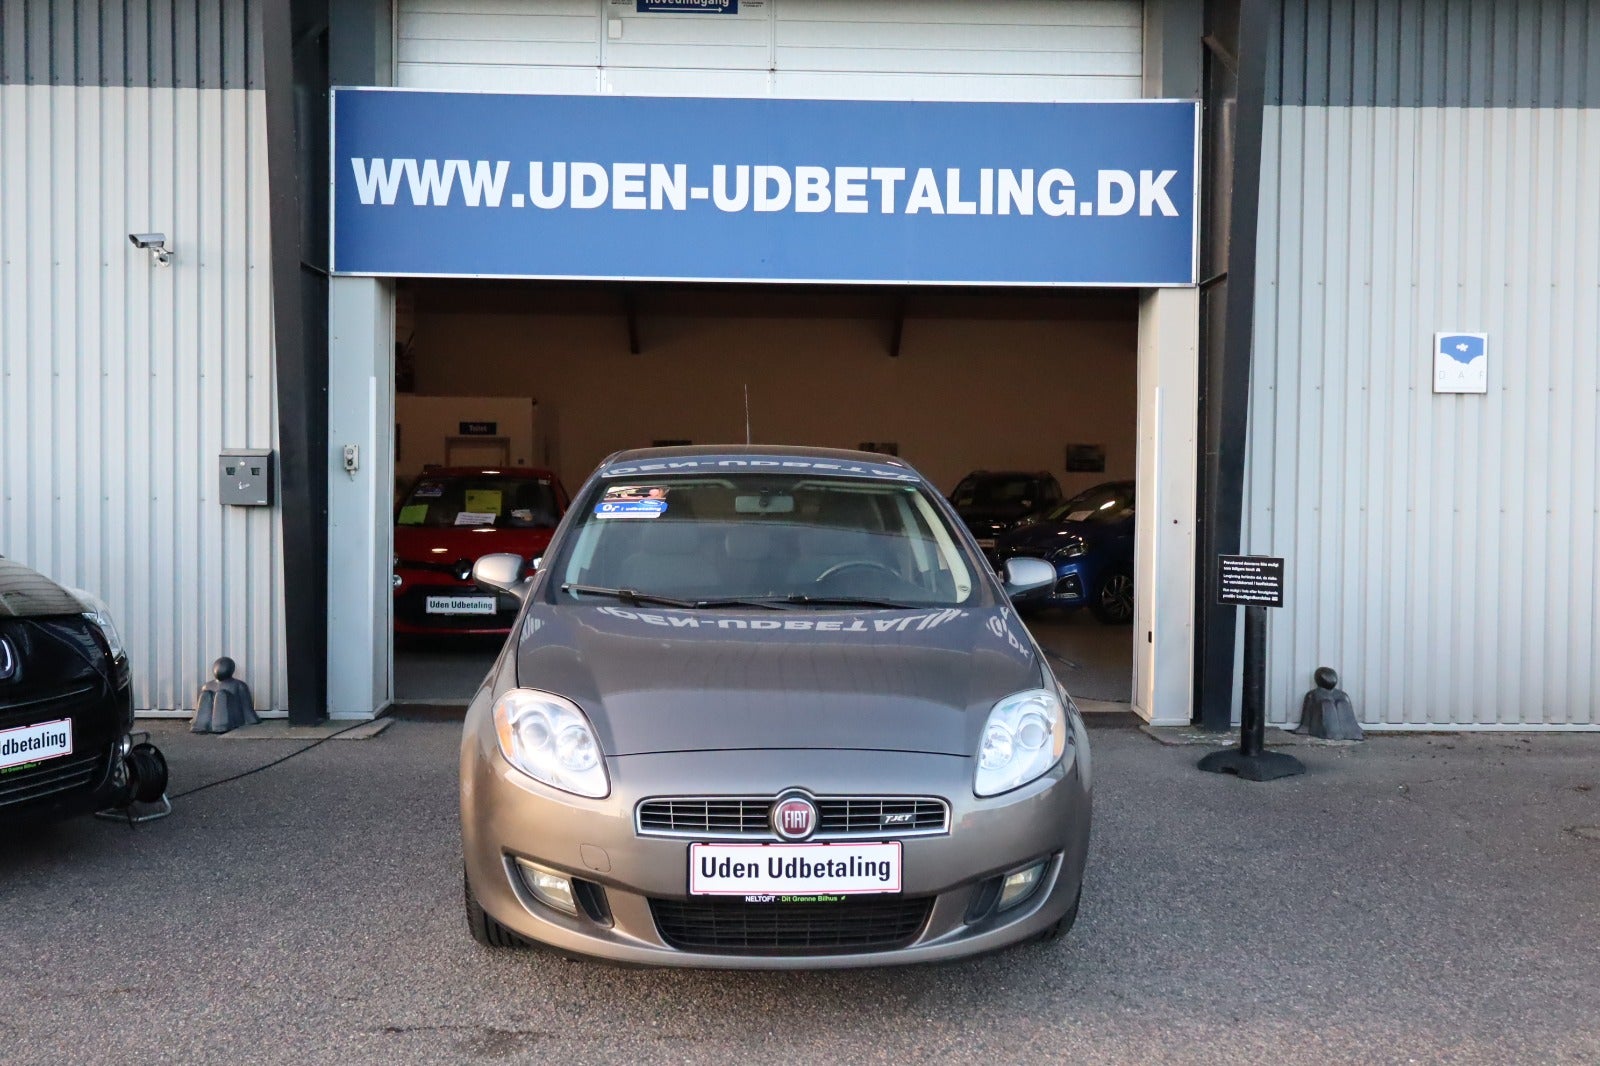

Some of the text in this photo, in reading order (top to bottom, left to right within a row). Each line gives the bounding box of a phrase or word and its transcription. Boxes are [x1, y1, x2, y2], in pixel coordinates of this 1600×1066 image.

[351, 157, 1180, 217] WWW.UDEN-UDBETALING.DK
[430, 600, 493, 610] Uden Udbetaling
[0, 731, 66, 756] dbetaling
[784, 810, 808, 829] FIAT
[701, 855, 891, 882] Uden Udbetaling
